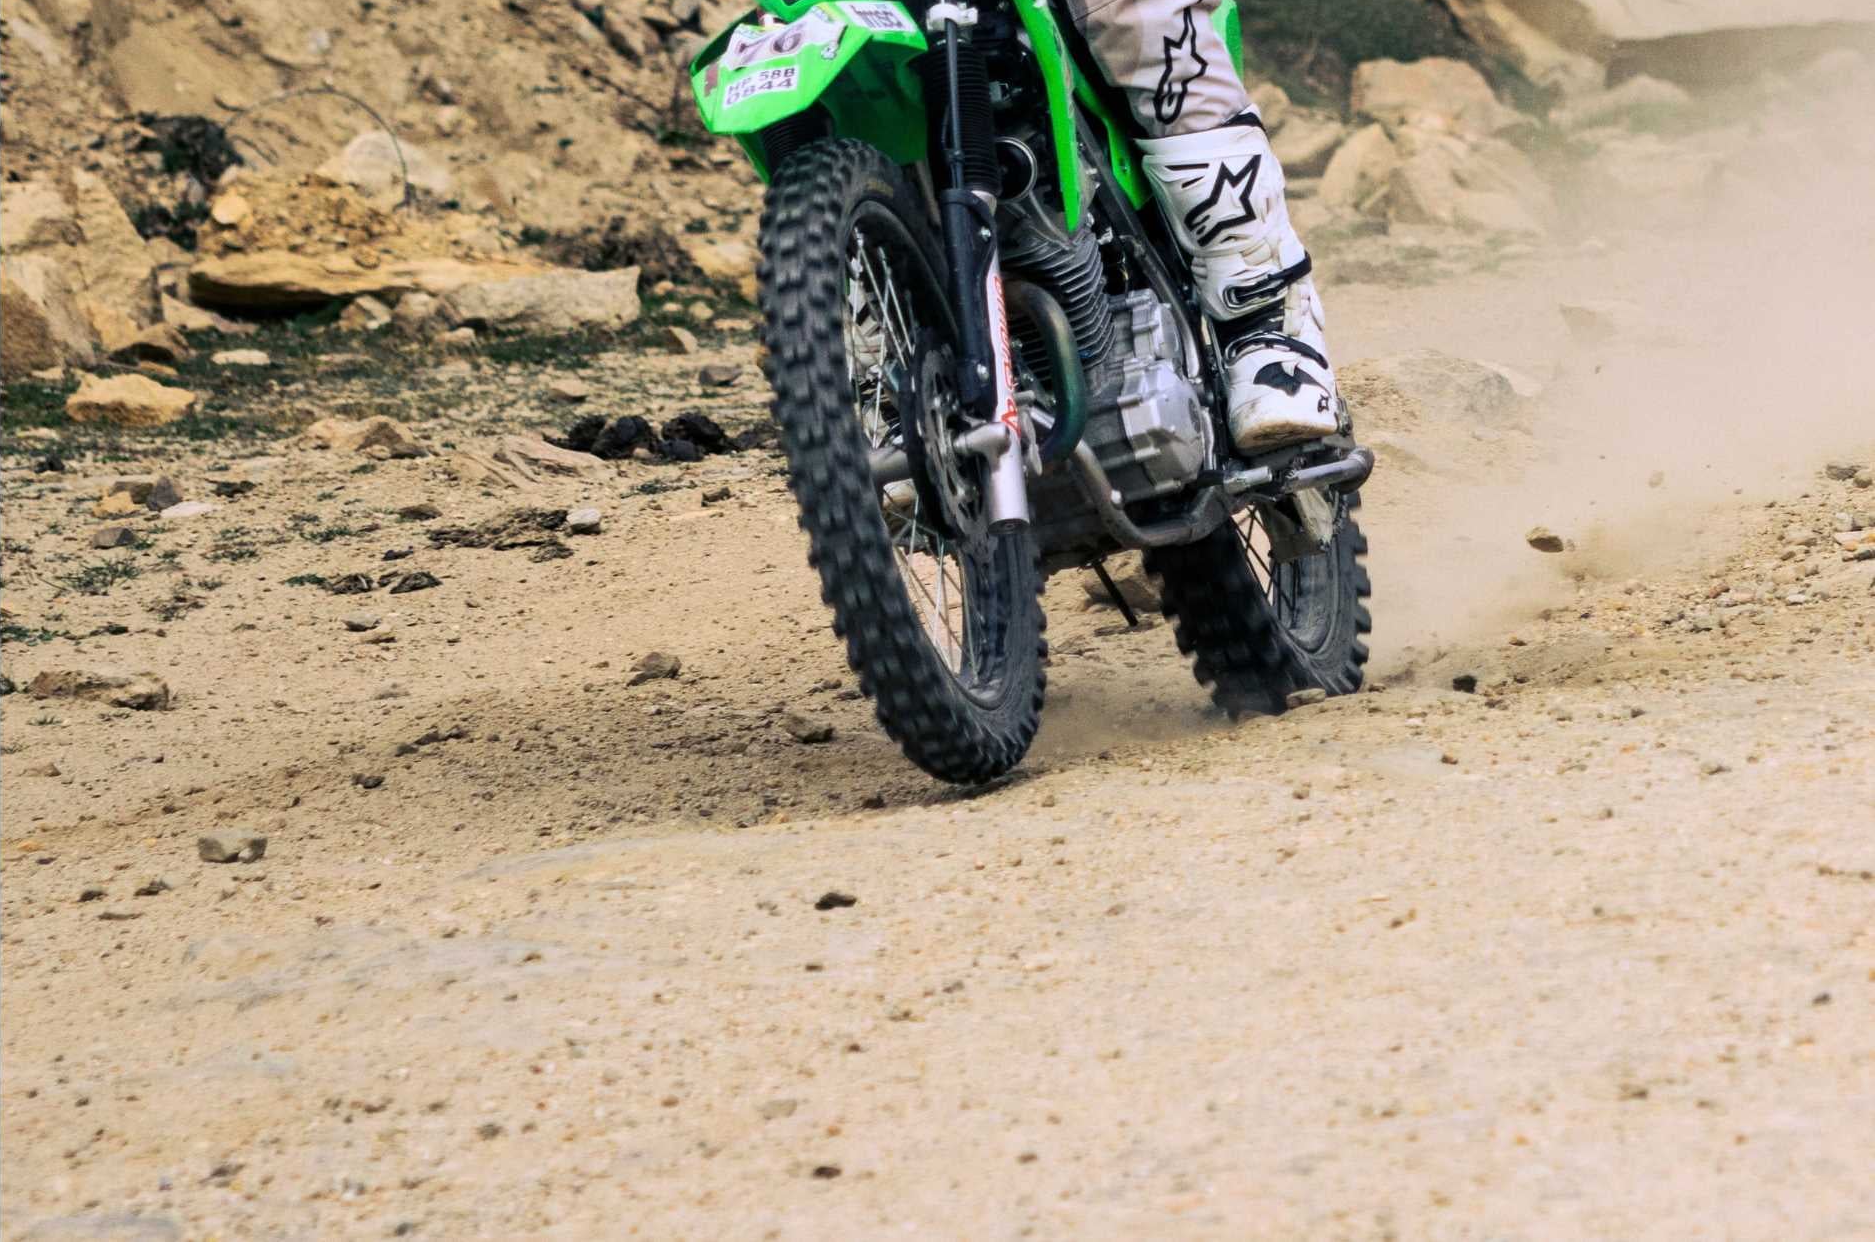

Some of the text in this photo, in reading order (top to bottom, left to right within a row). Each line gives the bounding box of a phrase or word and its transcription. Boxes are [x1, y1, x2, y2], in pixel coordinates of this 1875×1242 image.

[736, 21, 808, 65] 76
[727, 67, 796, 94] HP 58B
